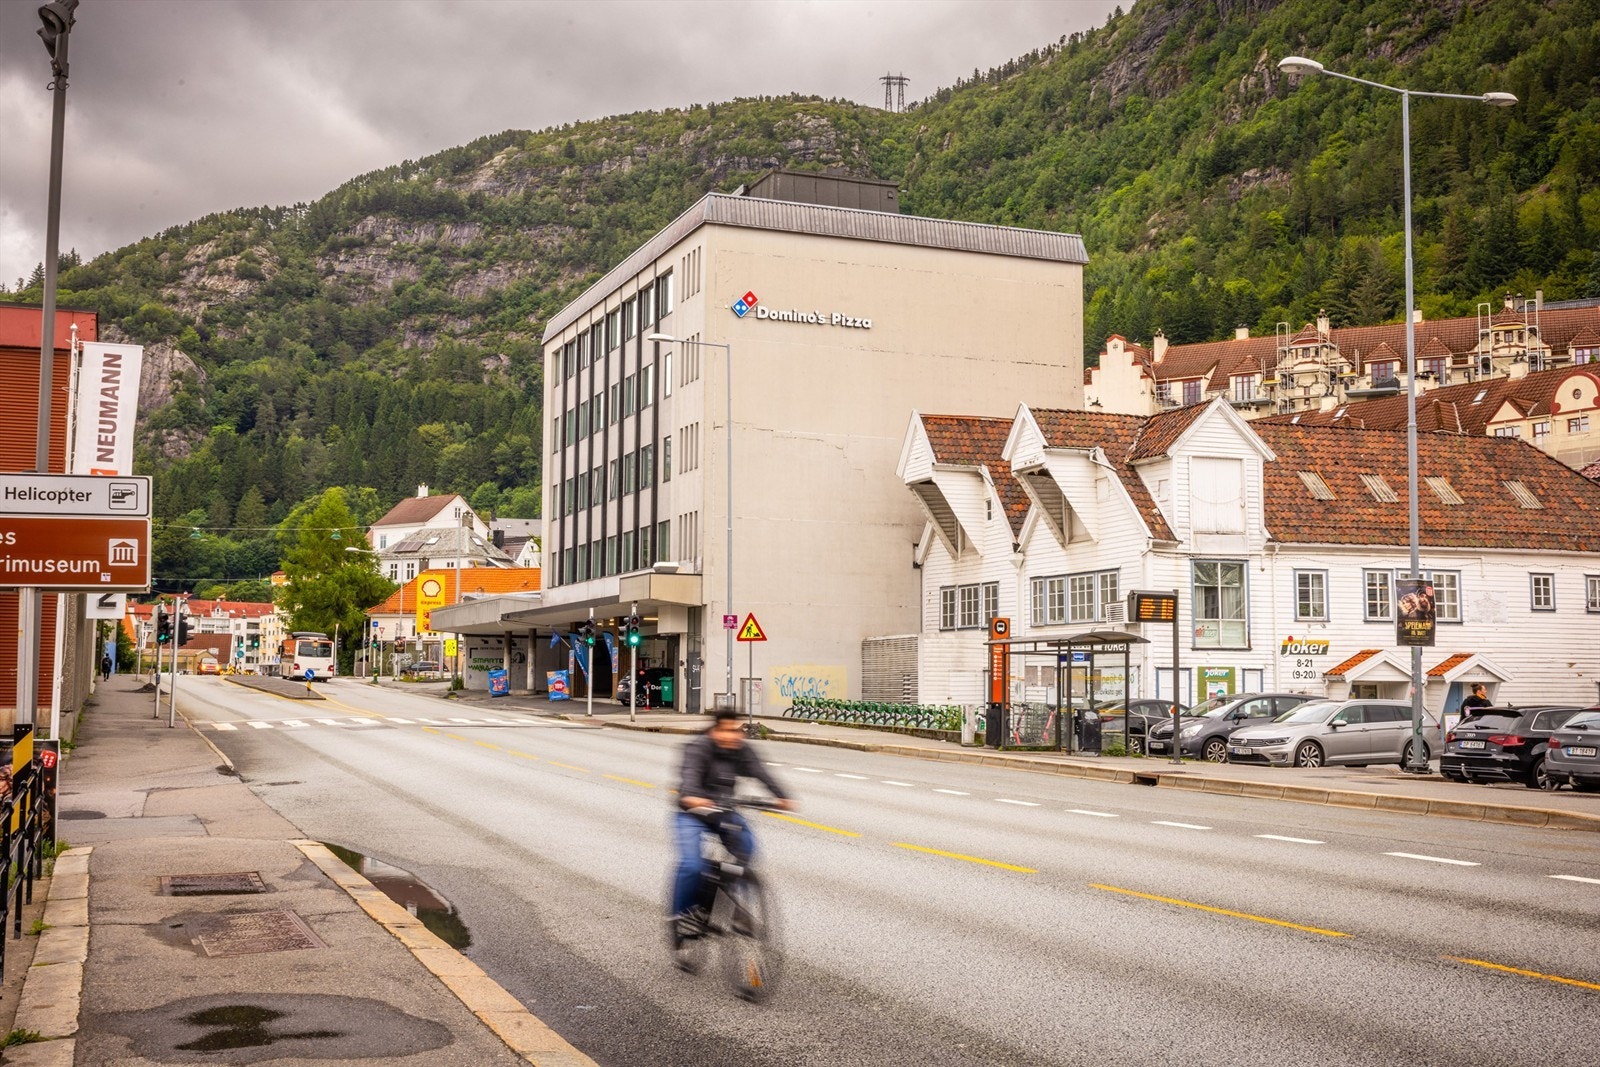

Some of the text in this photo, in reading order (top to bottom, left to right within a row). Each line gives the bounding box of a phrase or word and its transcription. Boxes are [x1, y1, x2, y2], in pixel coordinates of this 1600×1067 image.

[756, 306, 872, 329] Domino's Pizza
[96, 353, 122, 462] NEUMANN
[4, 486, 92, 504] Helicopter
[1281, 635, 1327, 658] joker
[1296, 659, 1313, 668] 8-21
[1292, 670, 1317, 679] (9-20)
